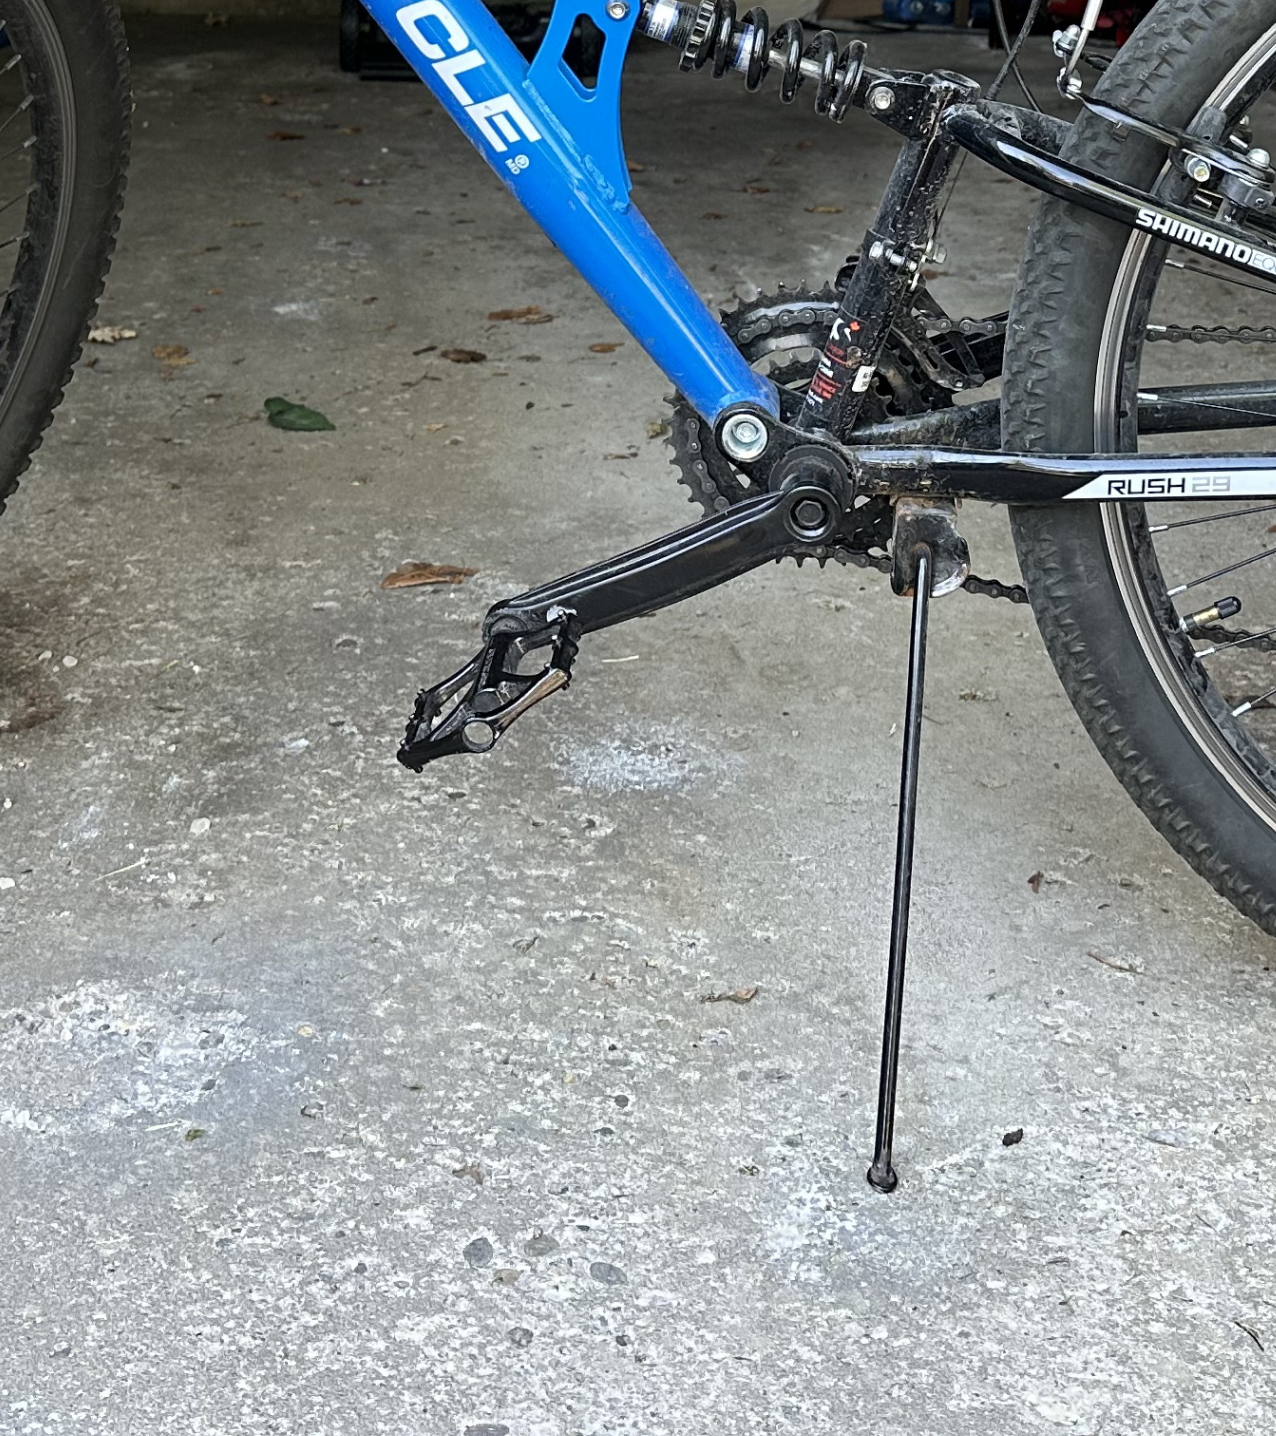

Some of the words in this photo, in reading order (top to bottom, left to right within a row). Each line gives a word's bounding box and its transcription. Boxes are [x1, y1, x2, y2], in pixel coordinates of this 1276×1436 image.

[1135, 208, 1253, 264] SHIMANO
[1108, 478, 1185, 495] RUSH
[1192, 476, 1231, 493] 29
